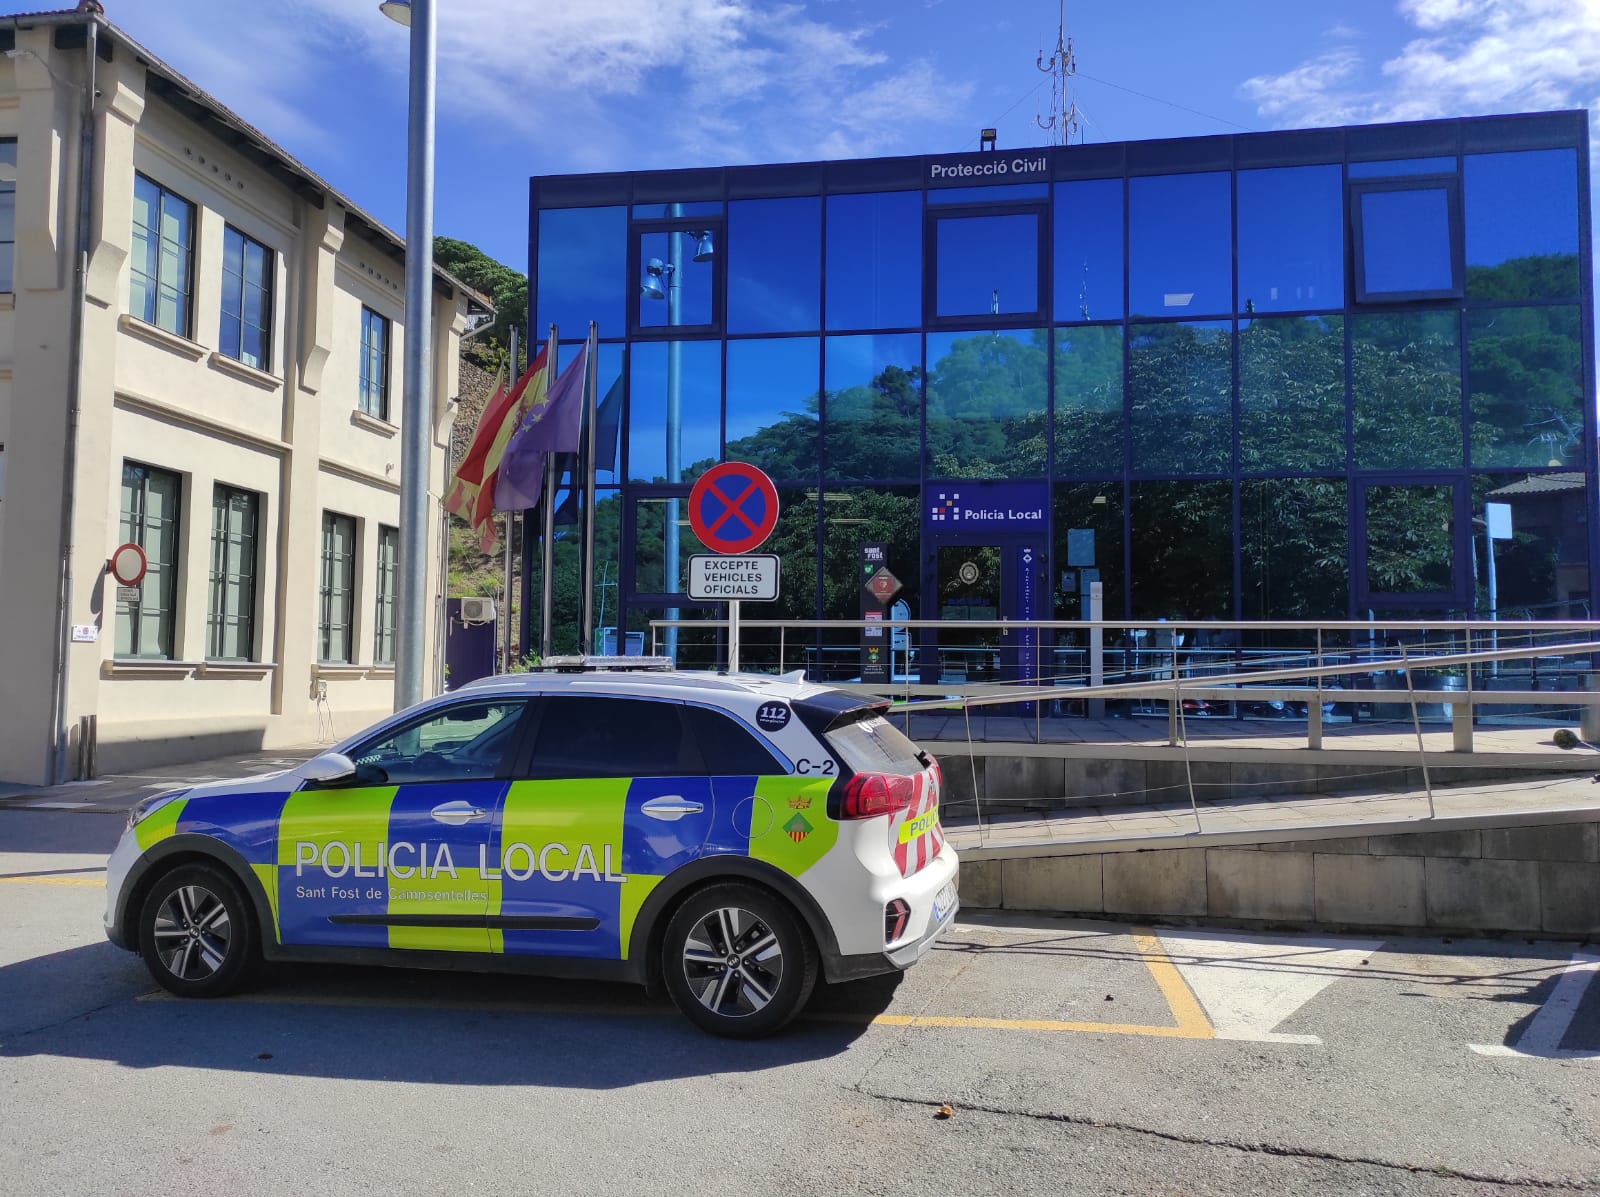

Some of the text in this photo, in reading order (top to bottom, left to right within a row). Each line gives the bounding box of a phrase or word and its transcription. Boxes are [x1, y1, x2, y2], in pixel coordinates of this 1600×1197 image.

[931, 157, 1047, 178] Protecció Civil
[964, 508, 1042, 520] Policia Local
[704, 560, 759, 570] EXCEPTE
[704, 573, 762, 582] VEHICLES
[703, 584, 759, 595] OFICIALS
[760, 706, 787, 719] 112
[796, 758, 834, 775] C-2
[295, 840, 628, 883] POLICIA LOCAL
[296, 886, 489, 902] Sant Fost de Campsentelles
